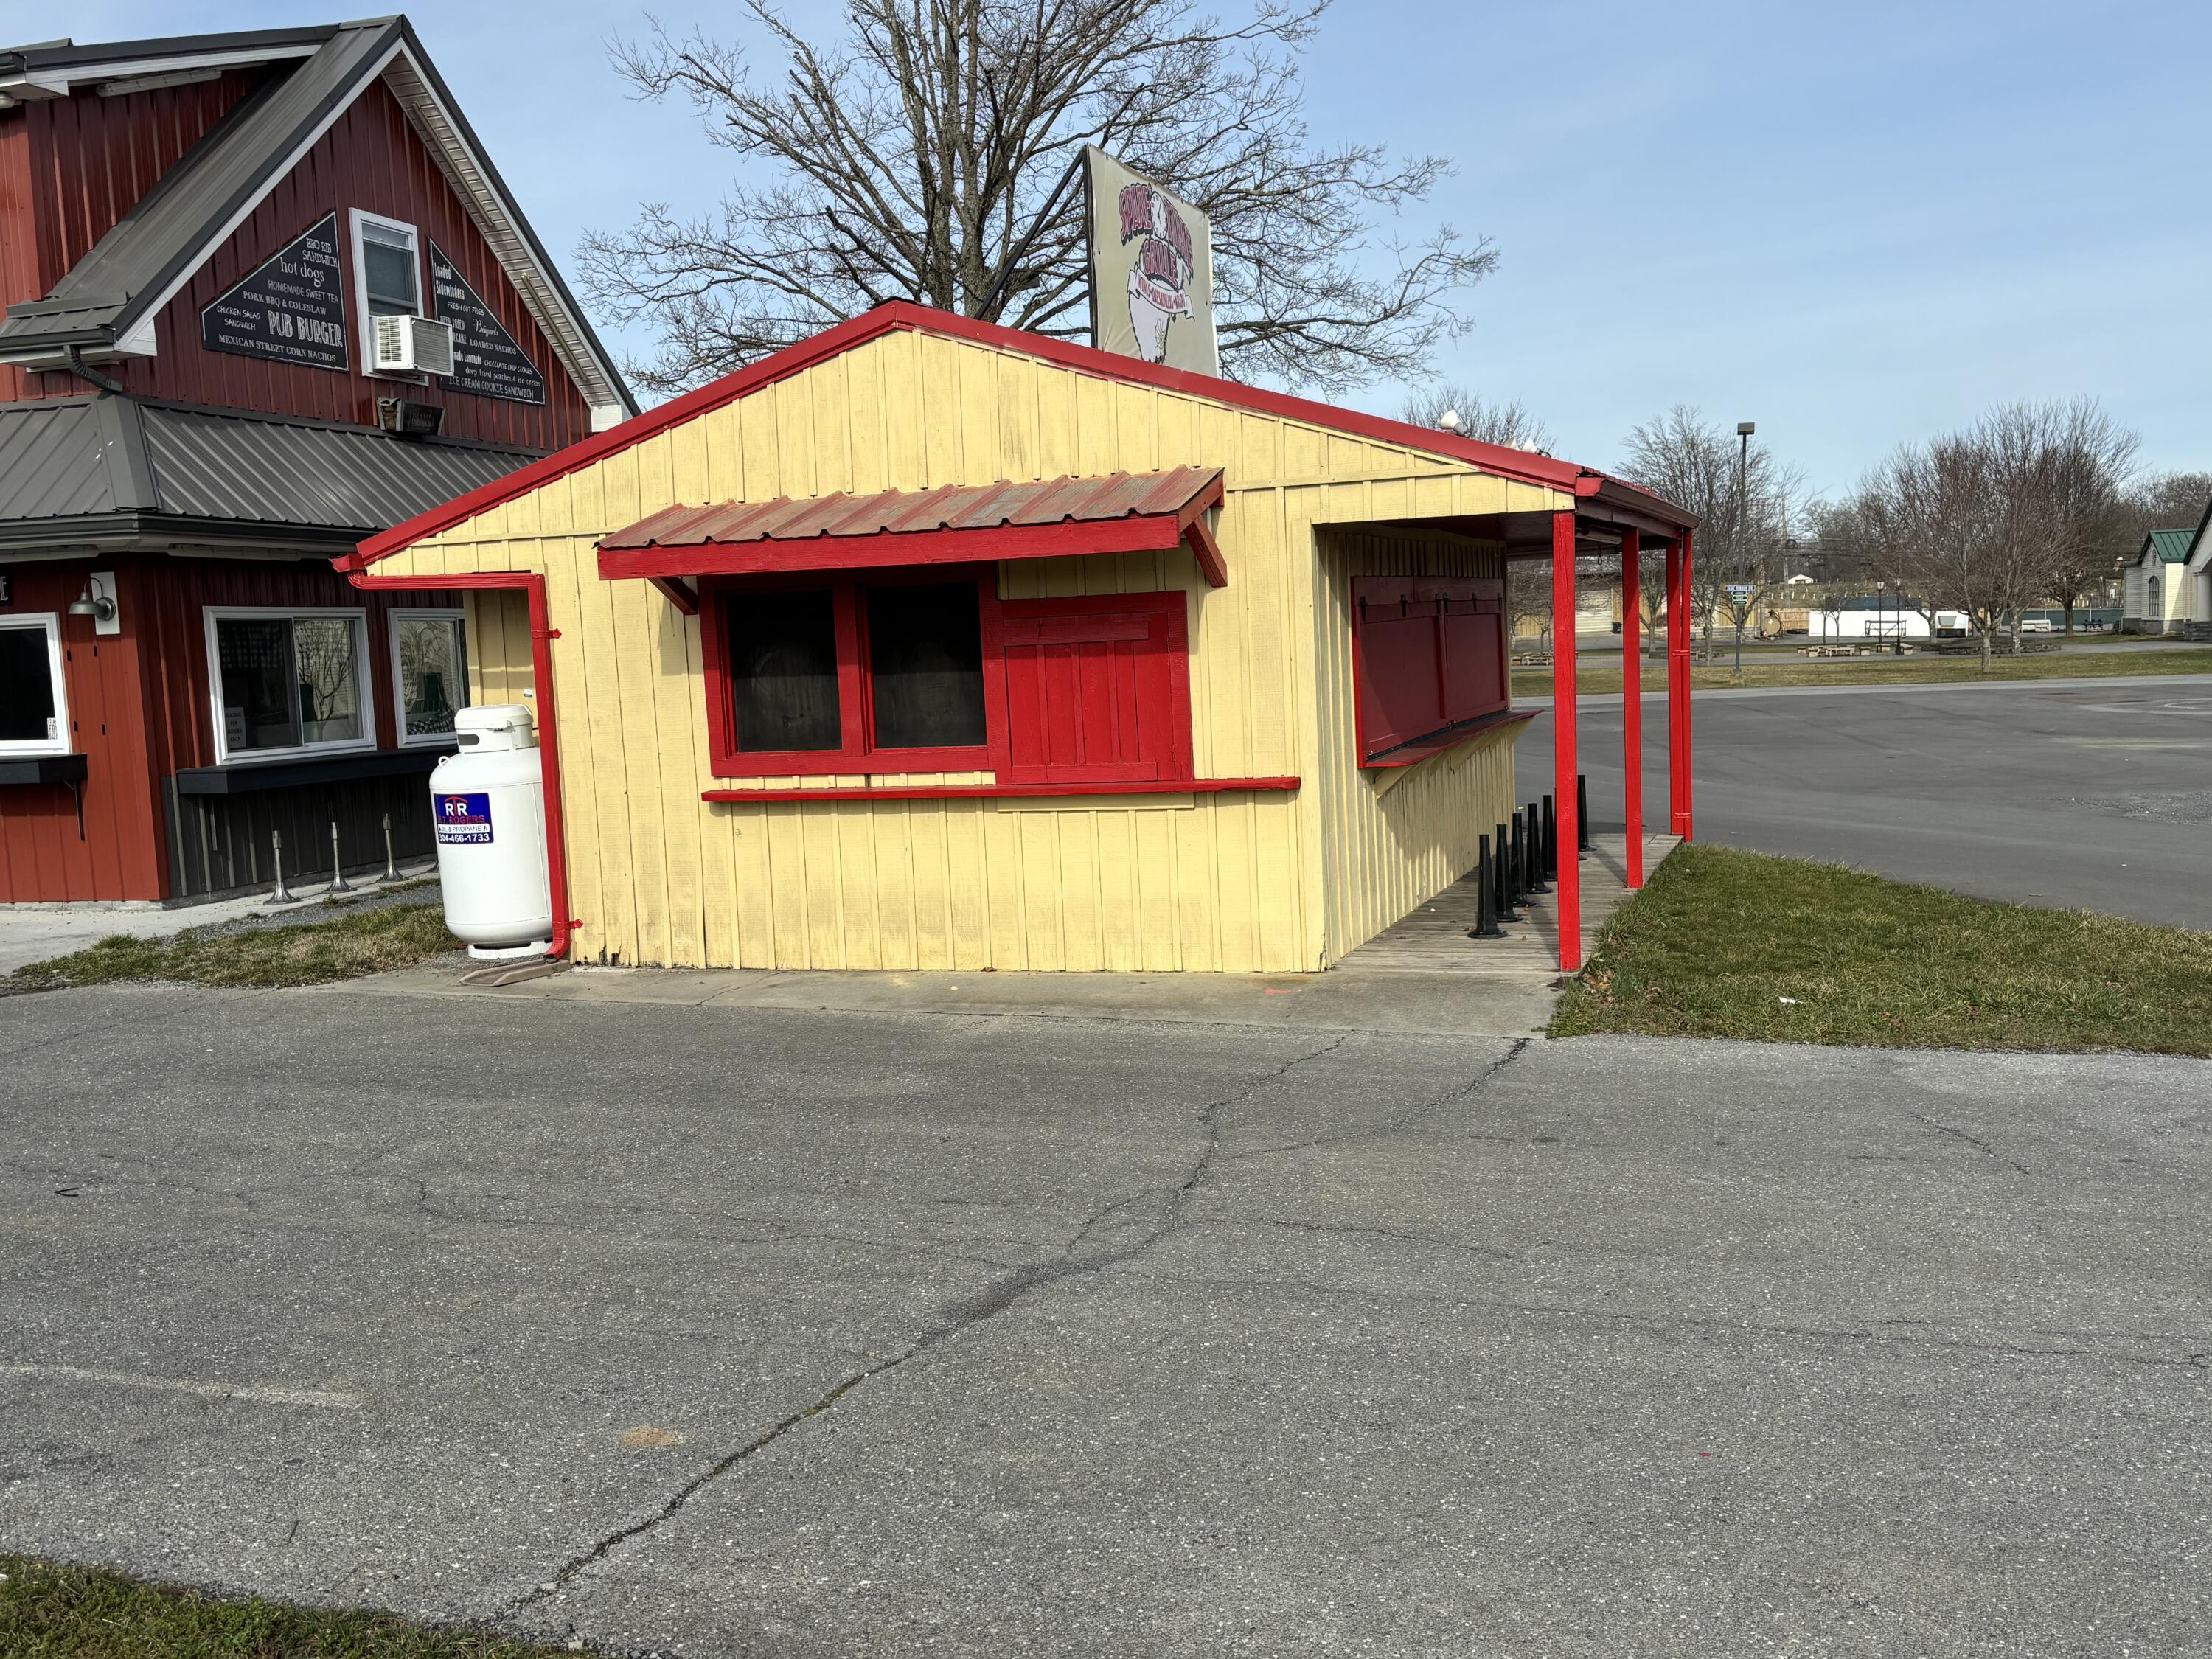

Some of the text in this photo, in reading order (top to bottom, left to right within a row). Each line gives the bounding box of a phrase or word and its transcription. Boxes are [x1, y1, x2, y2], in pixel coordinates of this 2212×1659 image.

[1119, 184, 1152, 243] SPARE
[1164, 195, 1194, 276] TIME
[321, 242, 332, 253] RIB
[302, 250, 338, 268] SANDWICH
[1143, 240, 1178, 289] GRILLE
[280, 257, 324, 288] hot dogs
[434, 262, 451, 279] Loaded
[268, 279, 339, 304] HOMEMADE SWEET TEA
[436, 279, 465, 299] Sidewinders
[217, 305, 260, 320] CHICKEN SALAD
[243, 291, 327, 316] PORK BBQ & COLESLAW
[447, 302, 484, 316] FRESH CUT FRIES
[224, 319, 256, 330] SANDWICH
[268, 310, 343, 347] PUB BURGER
[218, 334, 336, 362] MEXICAN STREET CORN NACHOS
[470, 338, 516, 355] LOADED NACHOS
[465, 366, 477, 377] deep
[479, 368, 492, 378] fried
[493, 372, 511, 382] peaches
[484, 360, 507, 370] CHOCOLATE
[518, 365, 533, 375] COOKIES
[449, 375, 534, 400] ICE CREAM COOKIE SANDWICH
[449, 815, 485, 824] ROGERS
